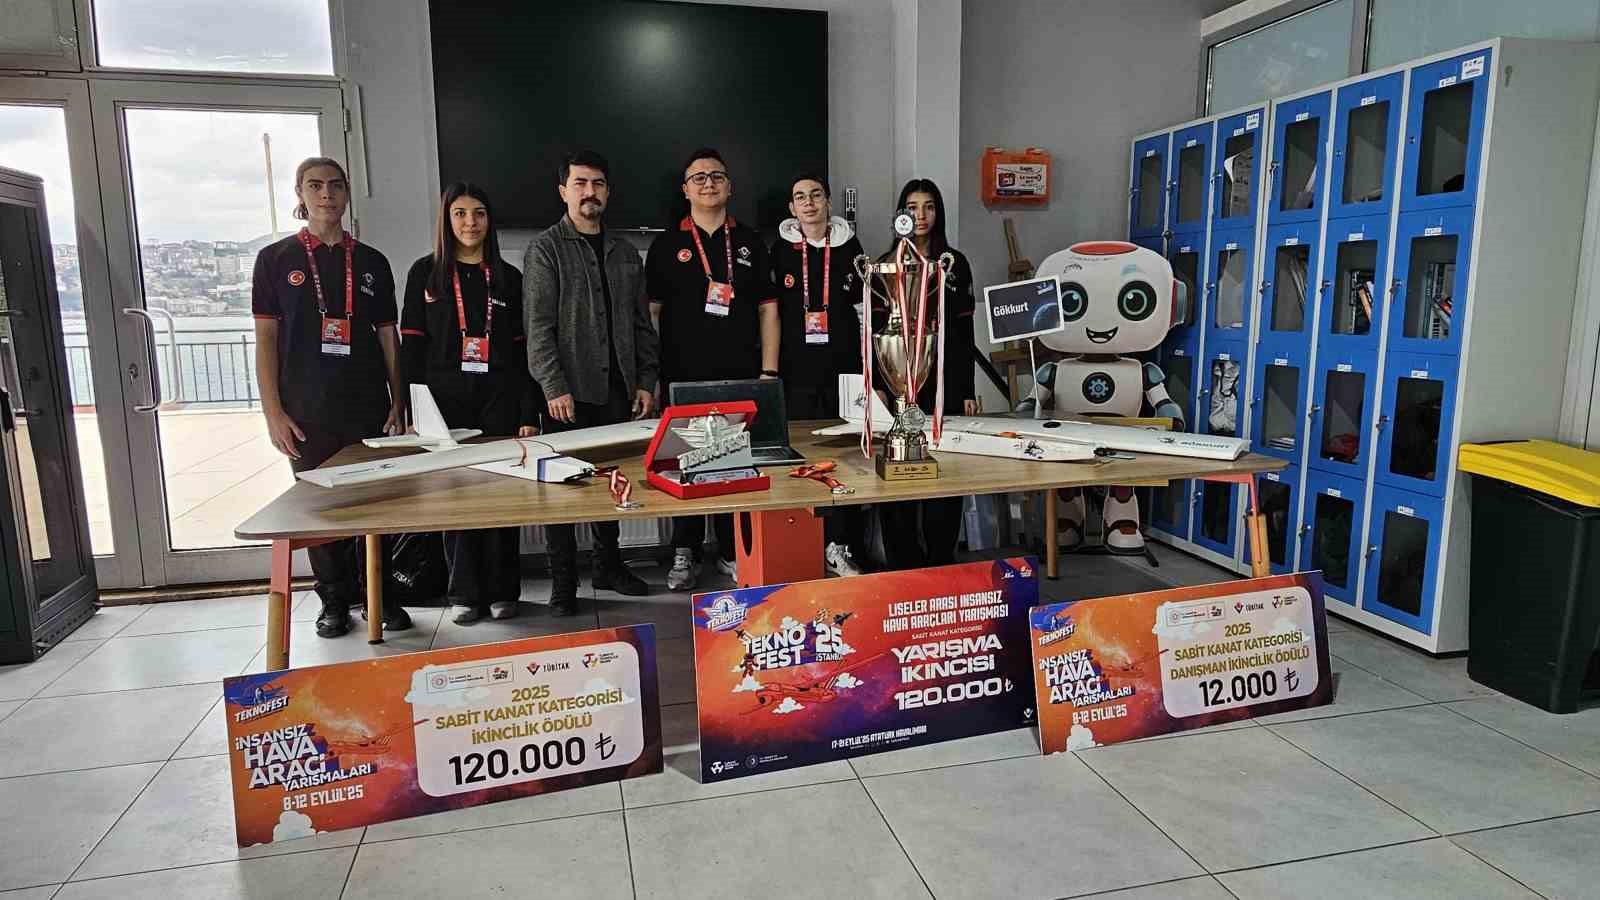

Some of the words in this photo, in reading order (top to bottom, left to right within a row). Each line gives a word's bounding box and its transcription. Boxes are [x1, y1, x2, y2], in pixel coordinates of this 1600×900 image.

[993, 302, 1029, 316] Gökkurt
[883, 617, 909, 632] HAVA
[959, 604, 1009, 622] YARIŞMASI
[1224, 622, 1252, 637] 2025
[742, 624, 806, 654] TEKNO
[891, 633, 1003, 663] YARIŞMA
[1039, 624, 1074, 645] TEKNOFEST
[1174, 644, 1206, 661] SABİT
[1207, 640, 1242, 656] KANAT
[1244, 629, 1303, 650] KATEGORİSİ
[756, 644, 805, 669] FEST
[1171, 661, 1227, 680] DANIŞMAN
[1229, 651, 1274, 672] İKİNCİLİK
[1276, 645, 1310, 663] ÖDÜLÜ
[1046, 660, 1096, 687] HAVA
[1199, 670, 1277, 707] 12.000
[511, 685, 550, 703] 2025
[894, 677, 1003, 710] 120.000
[234, 696, 288, 722] TEKNOFEST
[435, 710, 481, 730] SABİT
[484, 703, 535, 722] KANAT
[538, 688, 623, 714] KATEGORİSİ
[471, 721, 540, 745] İKİNCİLİK
[542, 711, 593, 734] ÖDÜLÜ
[244, 736, 319, 769] HAVA
[448, 737, 586, 785] 120.000
[283, 794, 308, 811] 8-12
